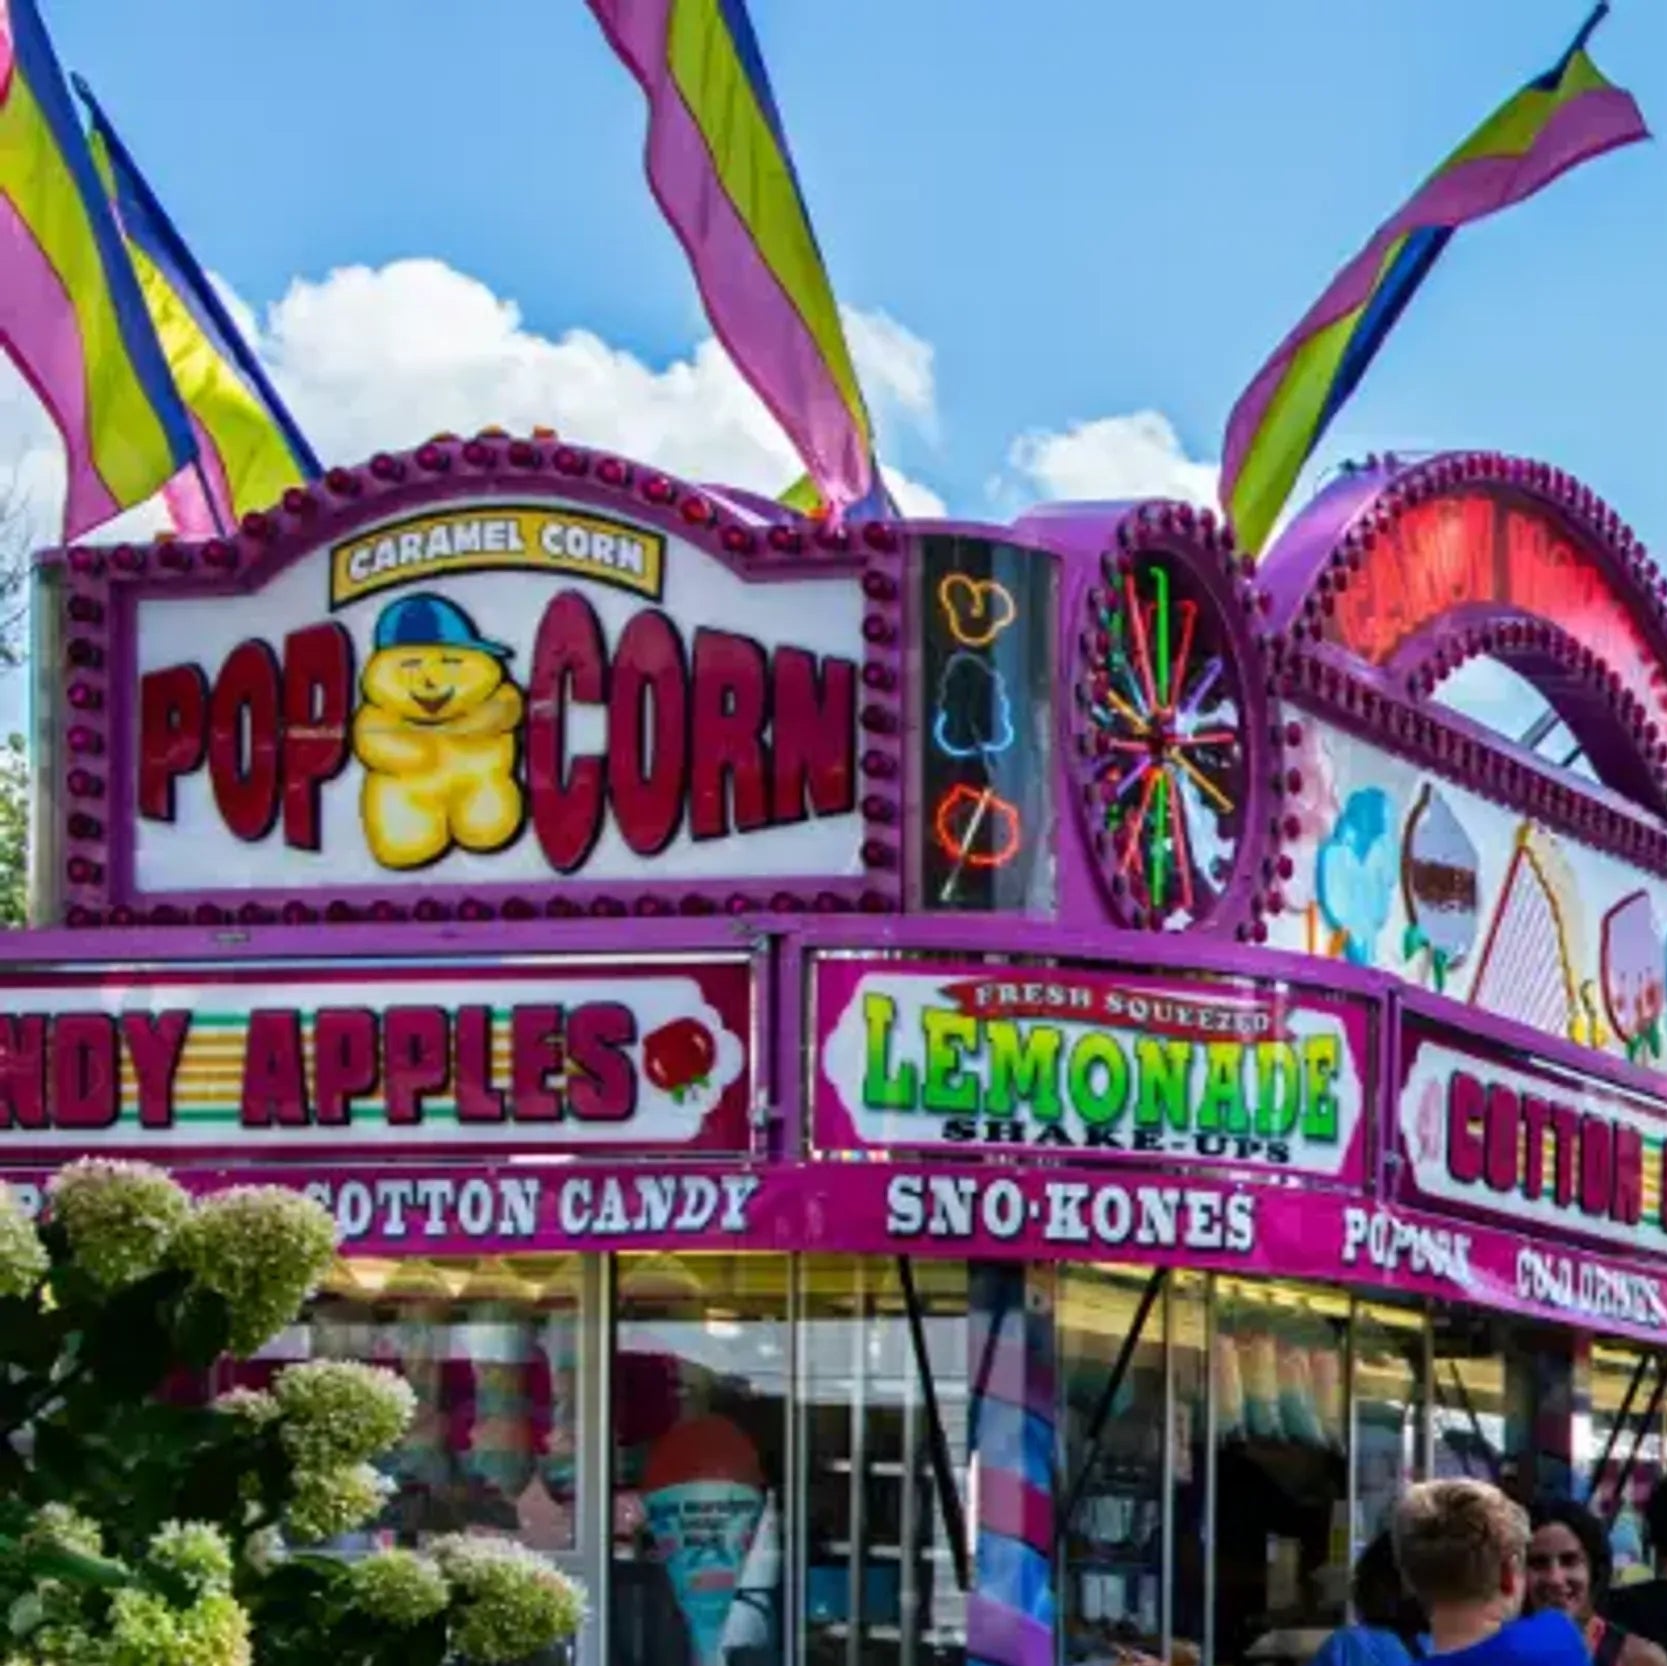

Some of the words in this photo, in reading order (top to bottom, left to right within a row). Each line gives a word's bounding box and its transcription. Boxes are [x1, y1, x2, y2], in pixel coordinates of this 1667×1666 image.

[350, 518, 523, 581] CARAMEL
[541, 520, 645, 574] CORN
[136, 619, 355, 852] POP
[526, 587, 859, 874] CORN
[974, 981, 1091, 1010] FRESH
[1106, 990, 1271, 1032] SQUEEZED
[0, 1008, 193, 1130] NDY
[240, 1002, 640, 1128] APPLES
[859, 991, 1341, 1144] LEMONADE
[941, 1115, 1291, 1164] SHAKE-UPS
[1446, 1070, 1643, 1227] COTTON
[559, 1175, 760, 1234] CANDY
